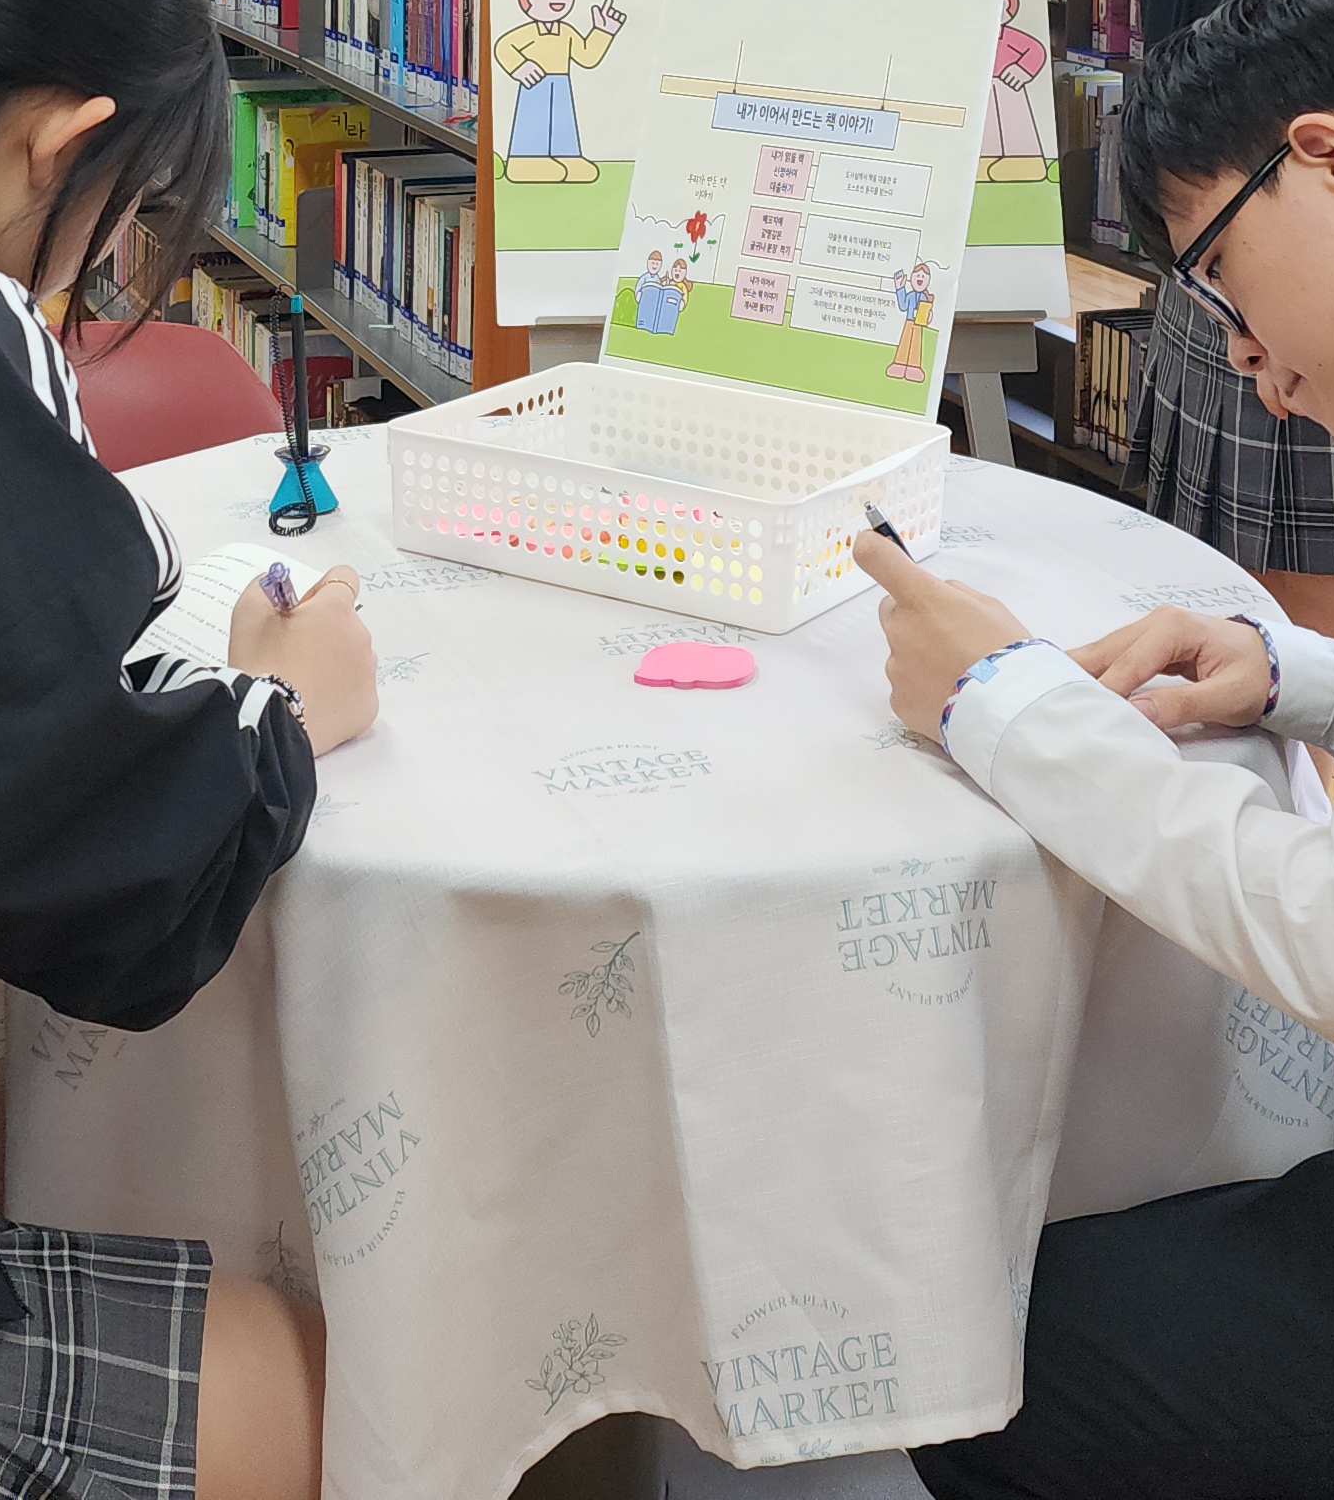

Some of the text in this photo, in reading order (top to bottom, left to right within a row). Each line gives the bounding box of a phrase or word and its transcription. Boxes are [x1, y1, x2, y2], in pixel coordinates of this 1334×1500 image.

[736, 102, 874, 135] 내가 이어서 만드는 책 이야기!
[770, 150, 784, 161] 내가
[687, 173, 706, 186] 우리가
[1119, 583, 1255, 604] MARKET
[531, 749, 709, 781] VINTAGE
[544, 761, 714, 796] MARKET
[836, 880, 998, 932] MARKET
[837, 917, 993, 973] VINTAGE
[300, 1090, 405, 1199] MARKE
[731, 1296, 787, 1340] FLOWER
[802, 1293, 850, 1320] PLANT
[700, 1331, 898, 1396] VINTAGE
[712, 1376, 900, 1440] MARKET
